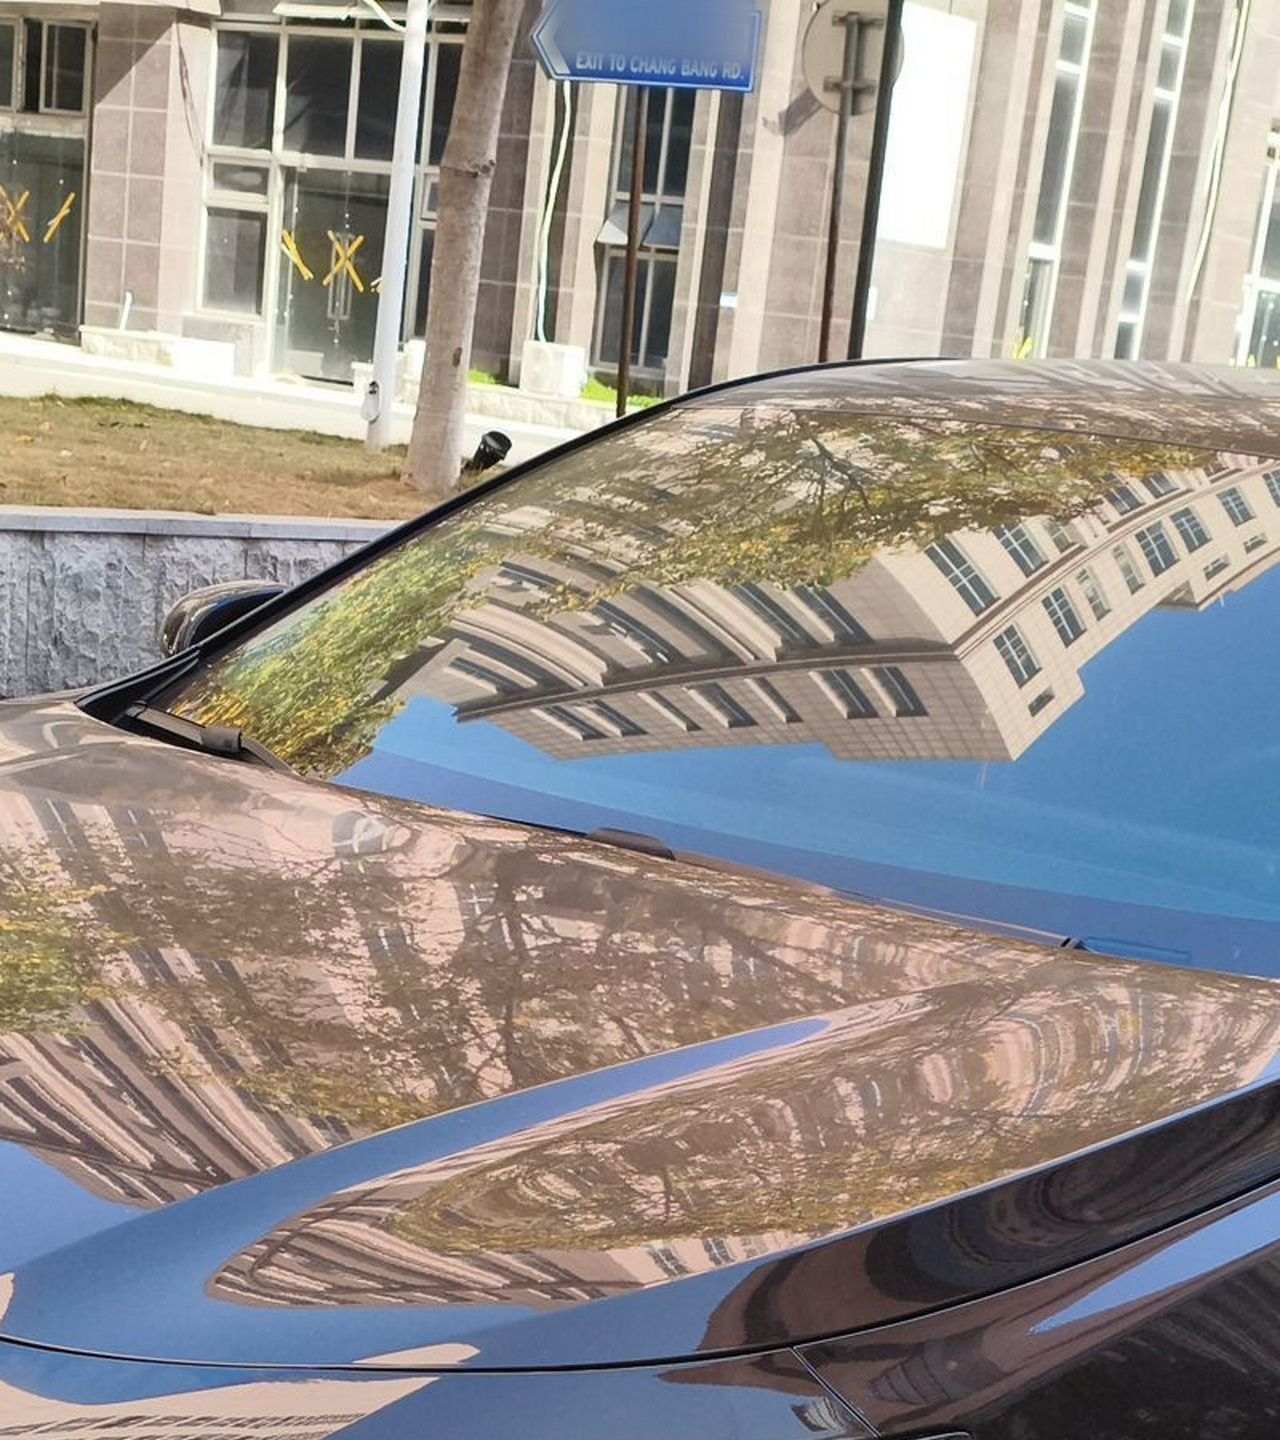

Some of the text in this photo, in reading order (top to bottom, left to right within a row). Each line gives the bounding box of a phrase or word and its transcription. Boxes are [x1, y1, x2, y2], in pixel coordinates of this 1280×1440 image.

[575, 51, 746, 80] EXIT TO CHANG BANG RD.
